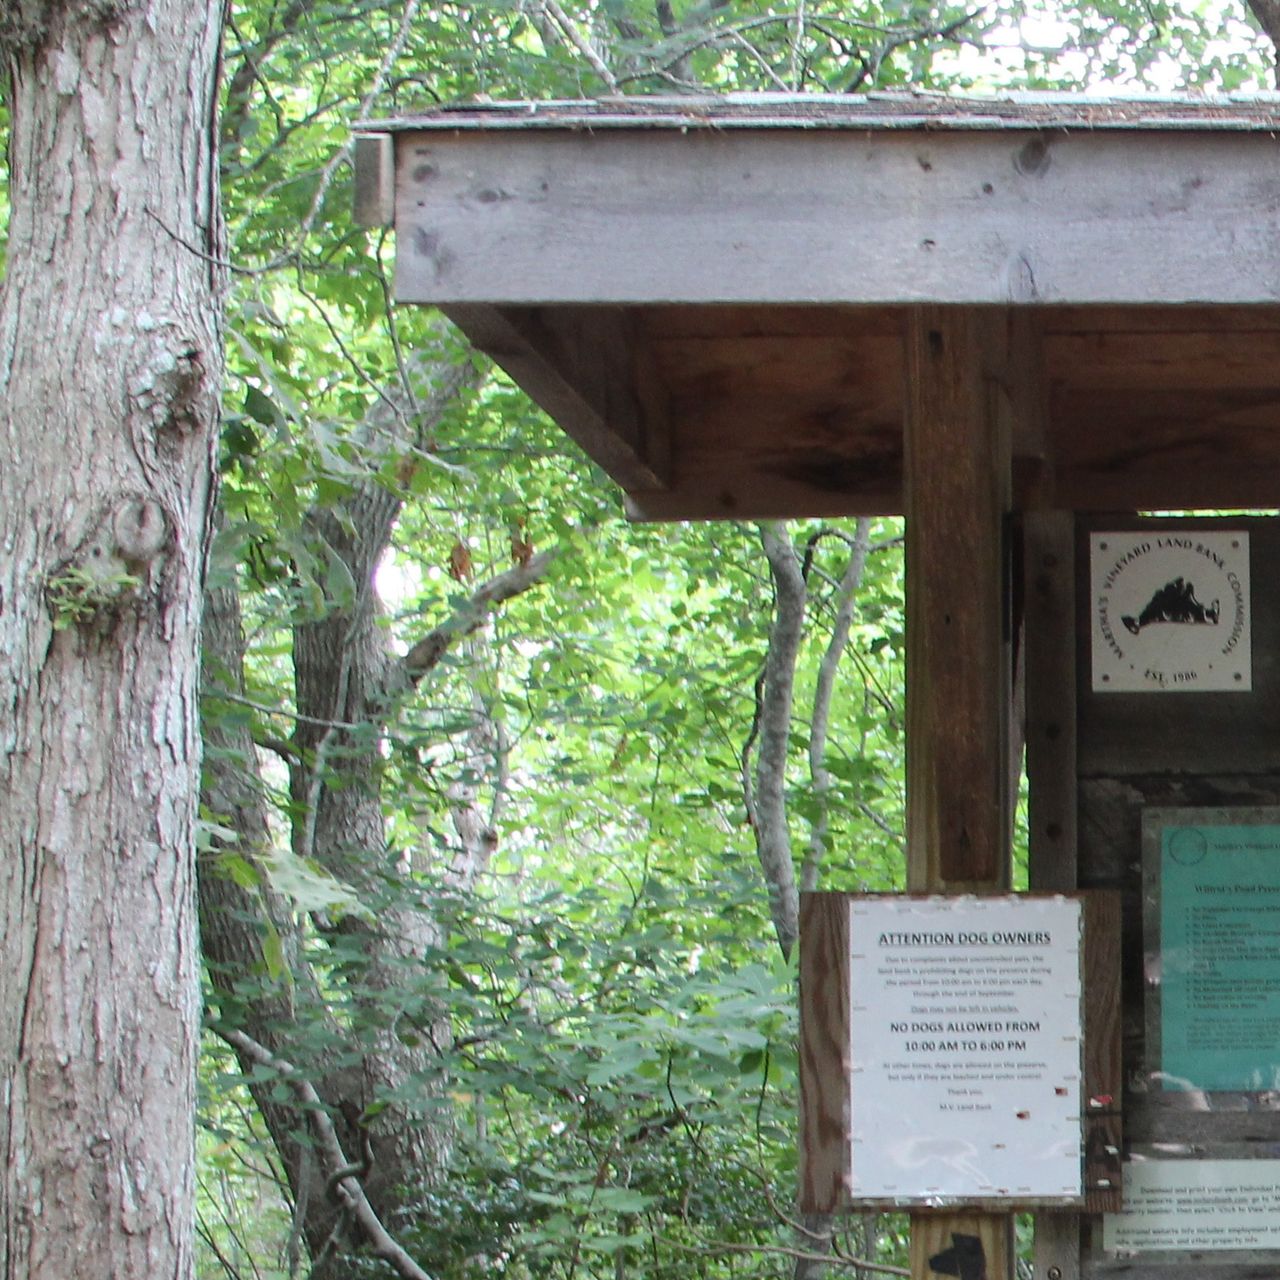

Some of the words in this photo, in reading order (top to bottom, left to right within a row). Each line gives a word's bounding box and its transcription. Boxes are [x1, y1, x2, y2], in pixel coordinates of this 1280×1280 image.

[1158, 538, 1193, 549] LAND
[879, 933, 954, 945] ATTENTION
[959, 933, 988, 945] DOG
[992, 932, 1050, 944] OWNERS
[891, 1023, 908, 1032] NO
[912, 1023, 943, 1032] DOGS
[947, 1022, 1002, 1032] ALLOWED
[1006, 1022, 1040, 1032] FROM
[906, 1041, 935, 1051] 10:00
[939, 1041, 958, 1051] AM
[962, 1041, 977, 1051] TO
[980, 1041, 1004, 1051] 6:00
[1008, 1041, 1026, 1050] PM
